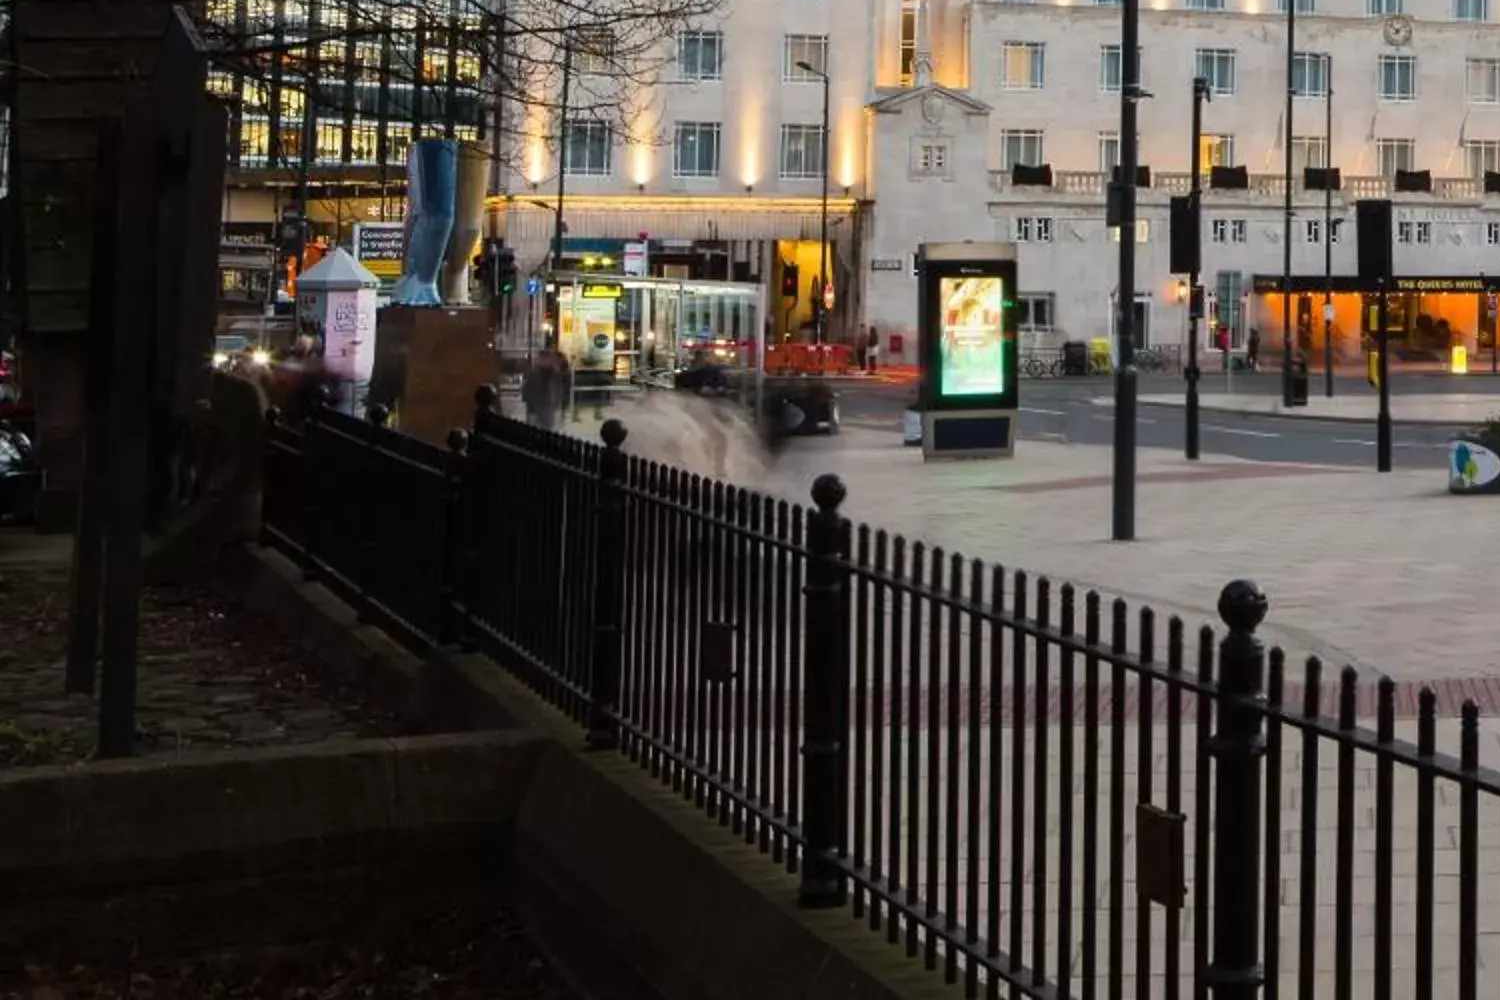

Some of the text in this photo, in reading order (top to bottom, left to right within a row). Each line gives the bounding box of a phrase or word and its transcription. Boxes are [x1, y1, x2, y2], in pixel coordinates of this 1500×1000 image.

[1397, 279, 1485, 289] THE QUEENS HOTEL
